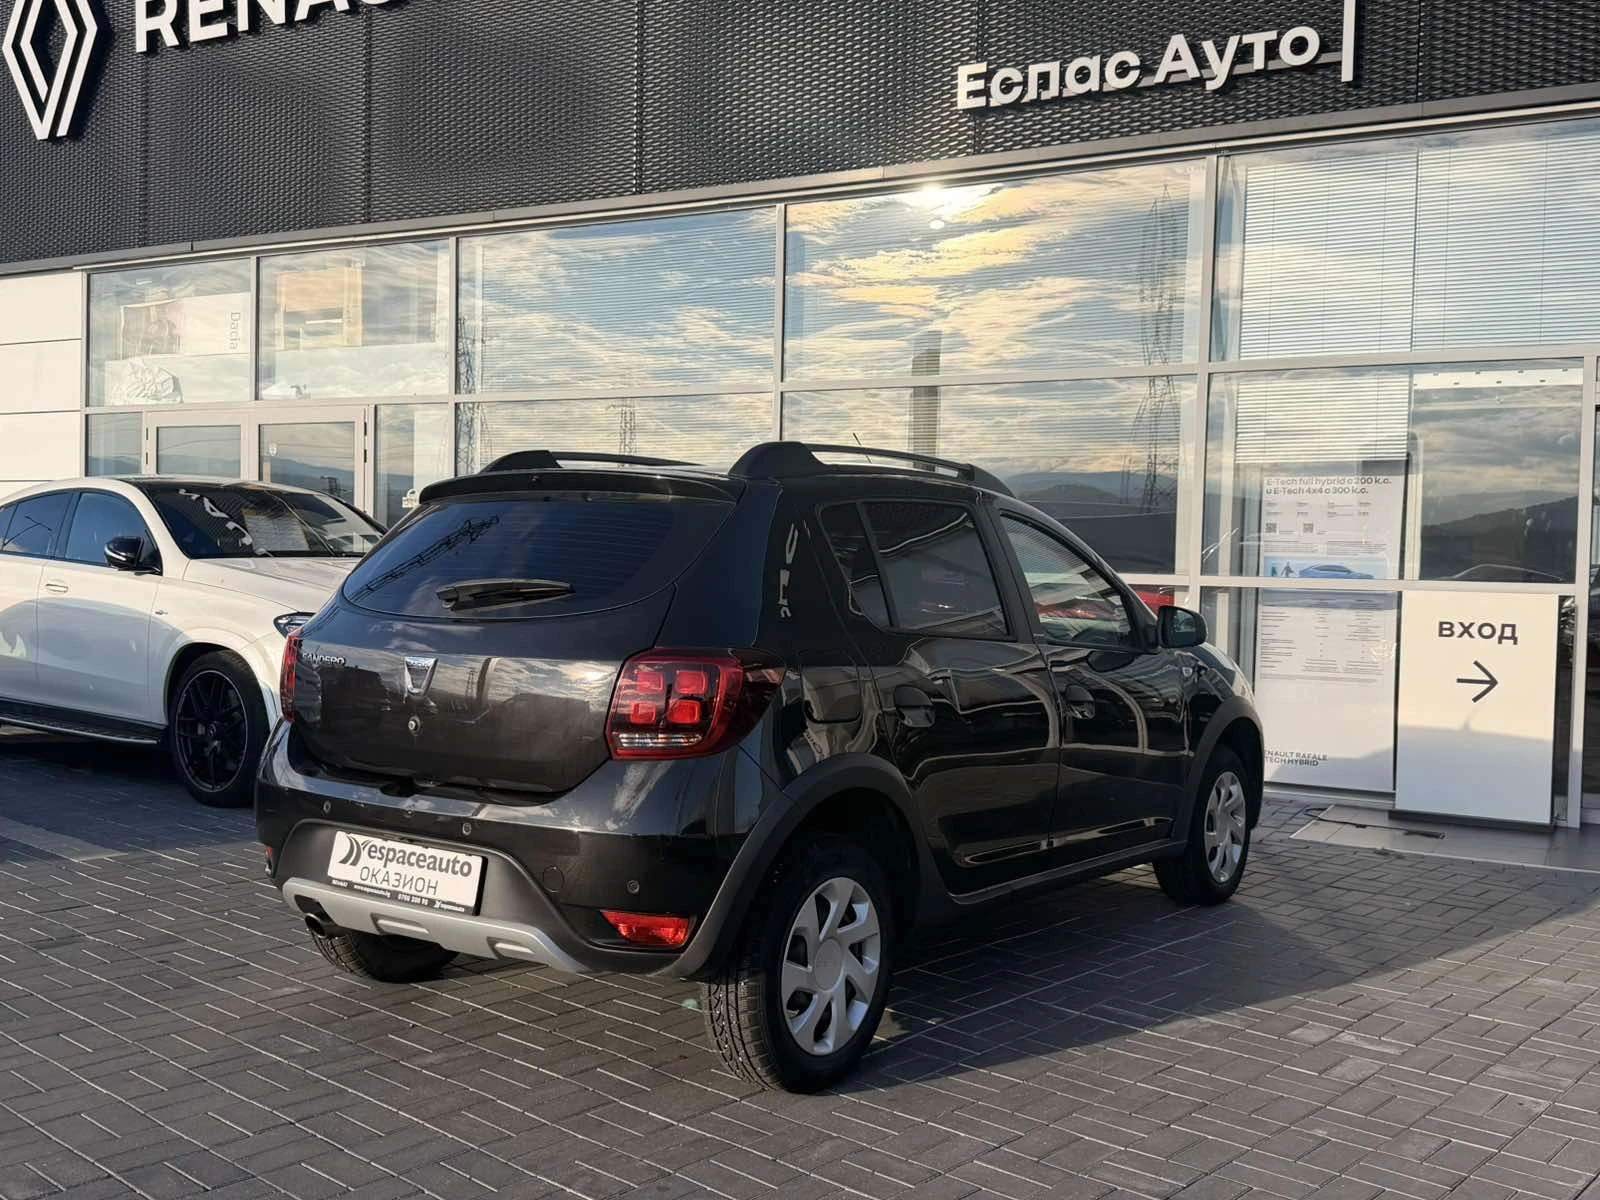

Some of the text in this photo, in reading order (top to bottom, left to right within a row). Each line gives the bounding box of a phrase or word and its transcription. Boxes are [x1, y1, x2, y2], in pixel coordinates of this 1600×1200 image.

[957, 26, 1320, 110] Еспас Ауто
[1315, 477, 1345, 487] hybrid
[1438, 621, 1518, 646] ВХОД
[1287, 758, 1319, 767] HYBRID
[367, 843, 473, 877] espaceauto
[359, 866, 439, 895] ОКАЗИОН
